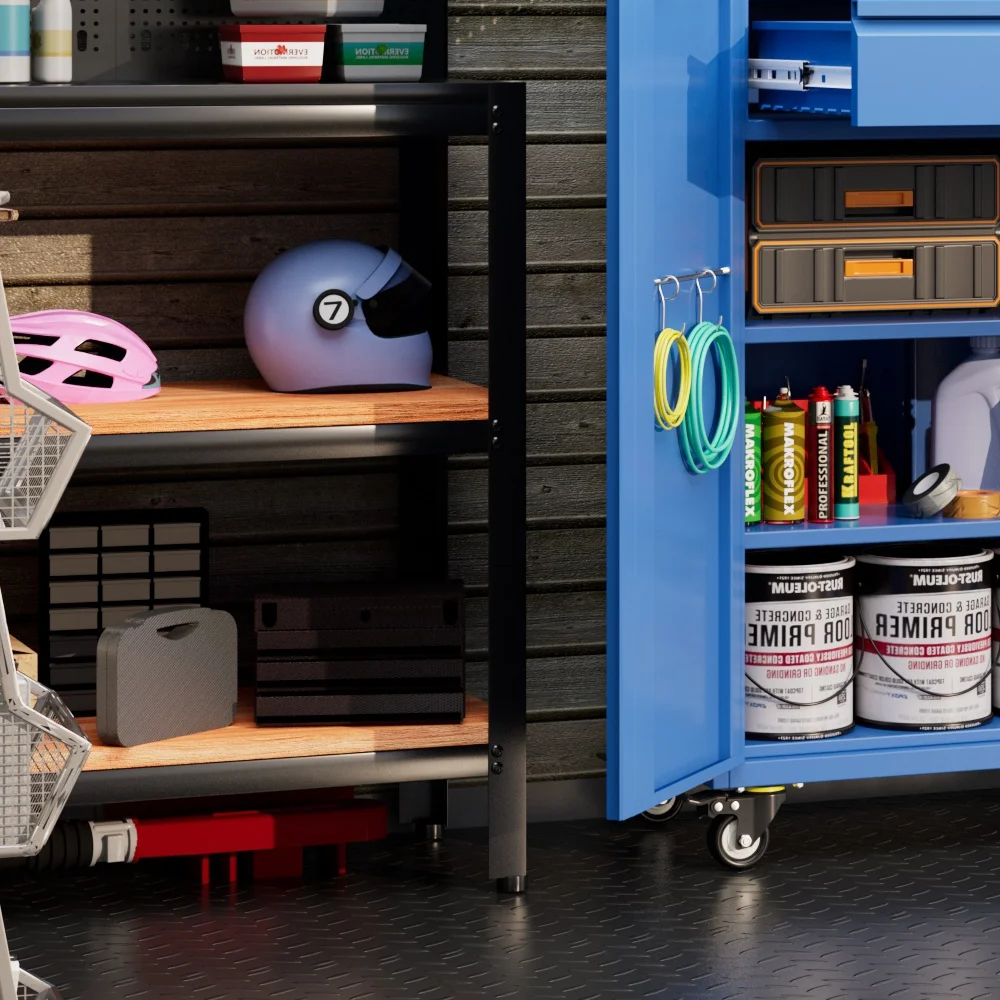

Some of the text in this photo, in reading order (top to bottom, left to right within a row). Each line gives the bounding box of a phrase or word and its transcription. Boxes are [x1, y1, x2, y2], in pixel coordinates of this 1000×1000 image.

[323, 300, 342, 320] 7
[745, 423, 755, 517] MAKROFLEX
[784, 422, 795, 515] MAKROFLEX
[818, 430, 828, 519] PROFESSIONAL
[841, 422, 858, 498] KRAFTOOL
